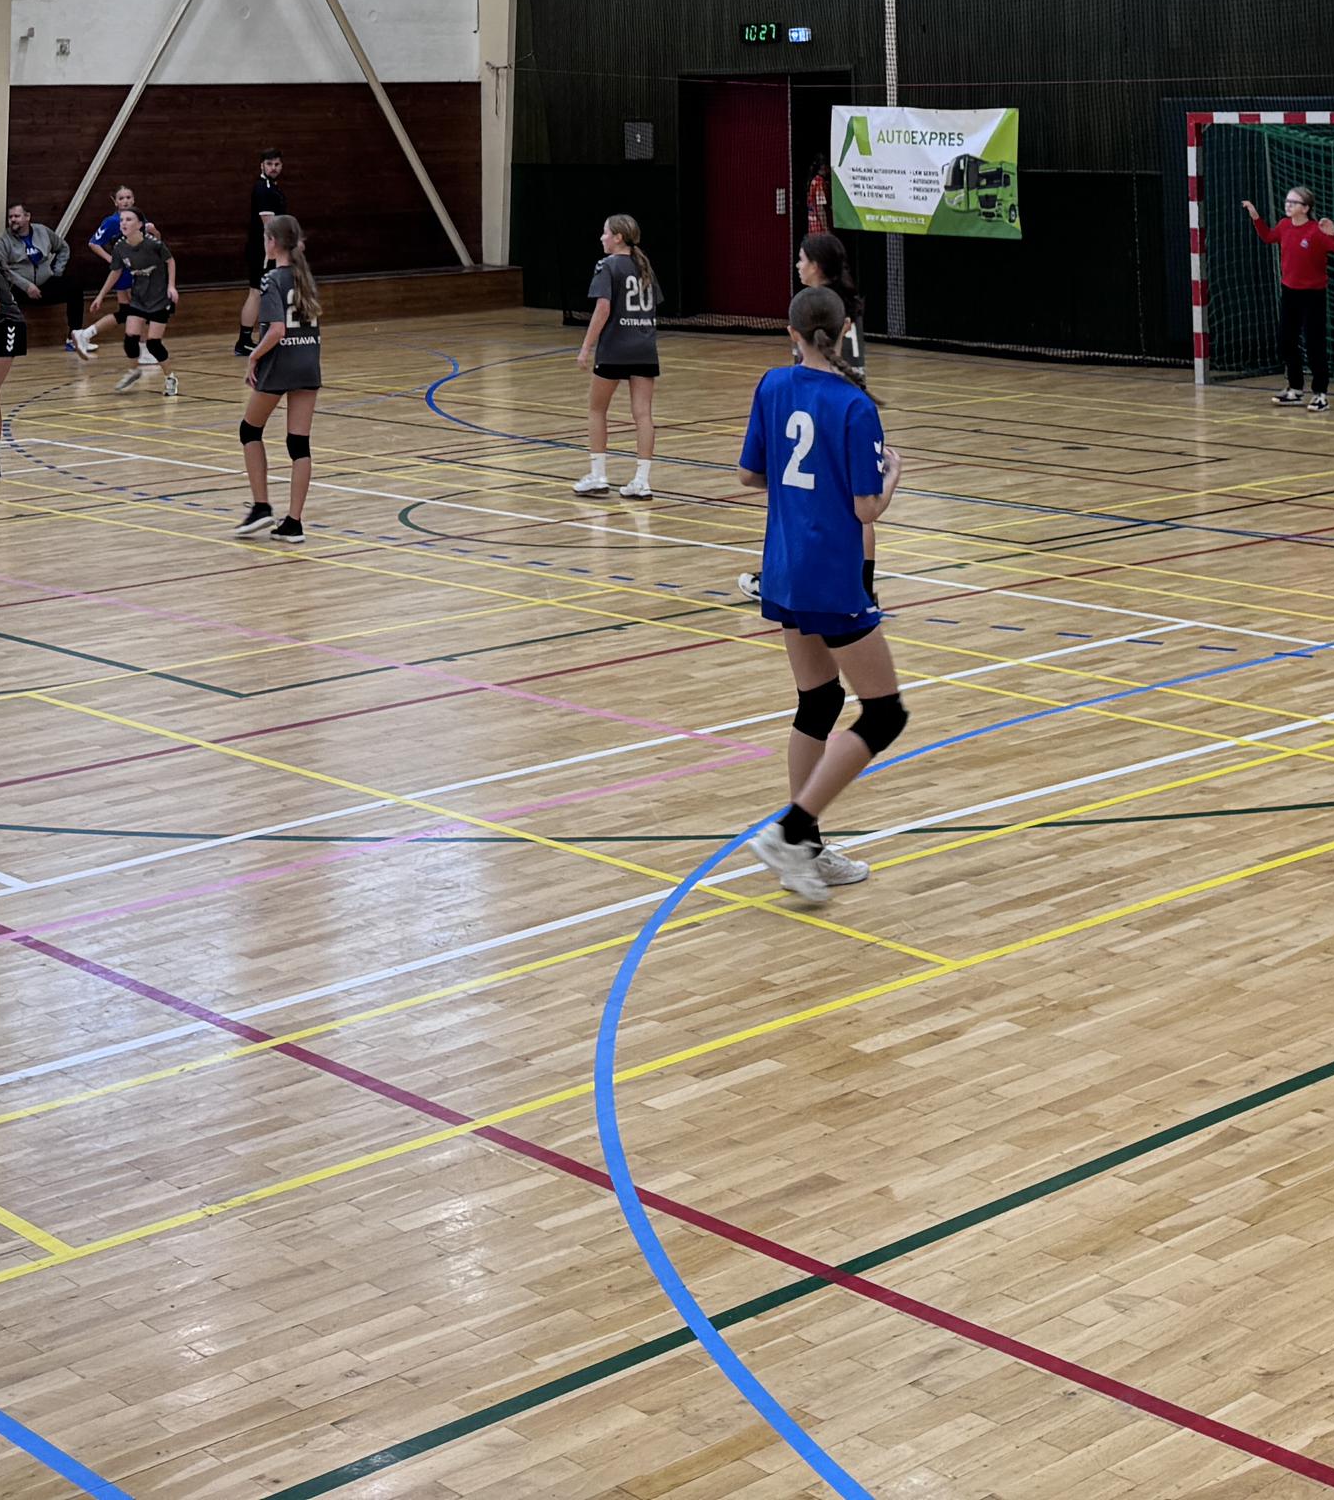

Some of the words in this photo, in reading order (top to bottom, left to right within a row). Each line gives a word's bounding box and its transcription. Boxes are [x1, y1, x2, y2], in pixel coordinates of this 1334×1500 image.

[877, 130, 964, 146] AUTOEXPRES
[286, 288, 318, 329] 2
[781, 410, 815, 490] 2
